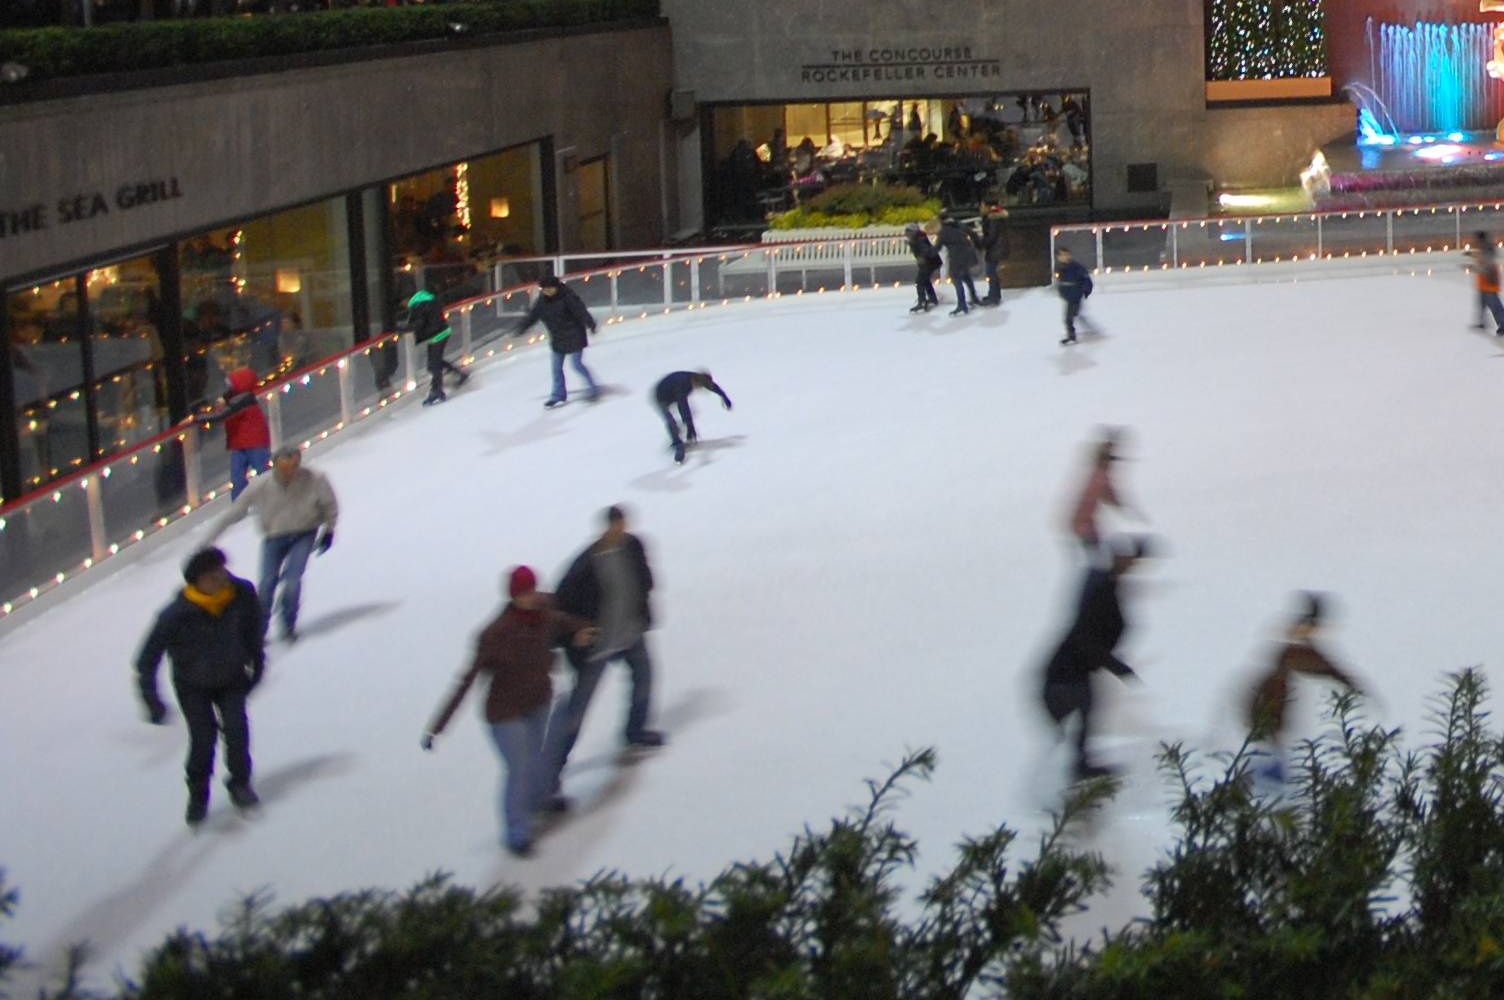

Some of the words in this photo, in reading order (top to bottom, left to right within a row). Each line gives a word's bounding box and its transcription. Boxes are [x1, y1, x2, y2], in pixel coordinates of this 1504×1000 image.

[831, 50, 863, 64] THE
[869, 46, 973, 63] CONCOURSE
[801, 65, 926, 84] ROCKEFELLER
[933, 63, 1001, 80] CENTER
[57, 191, 109, 224] SEA
[115, 176, 184, 210] GRILL
